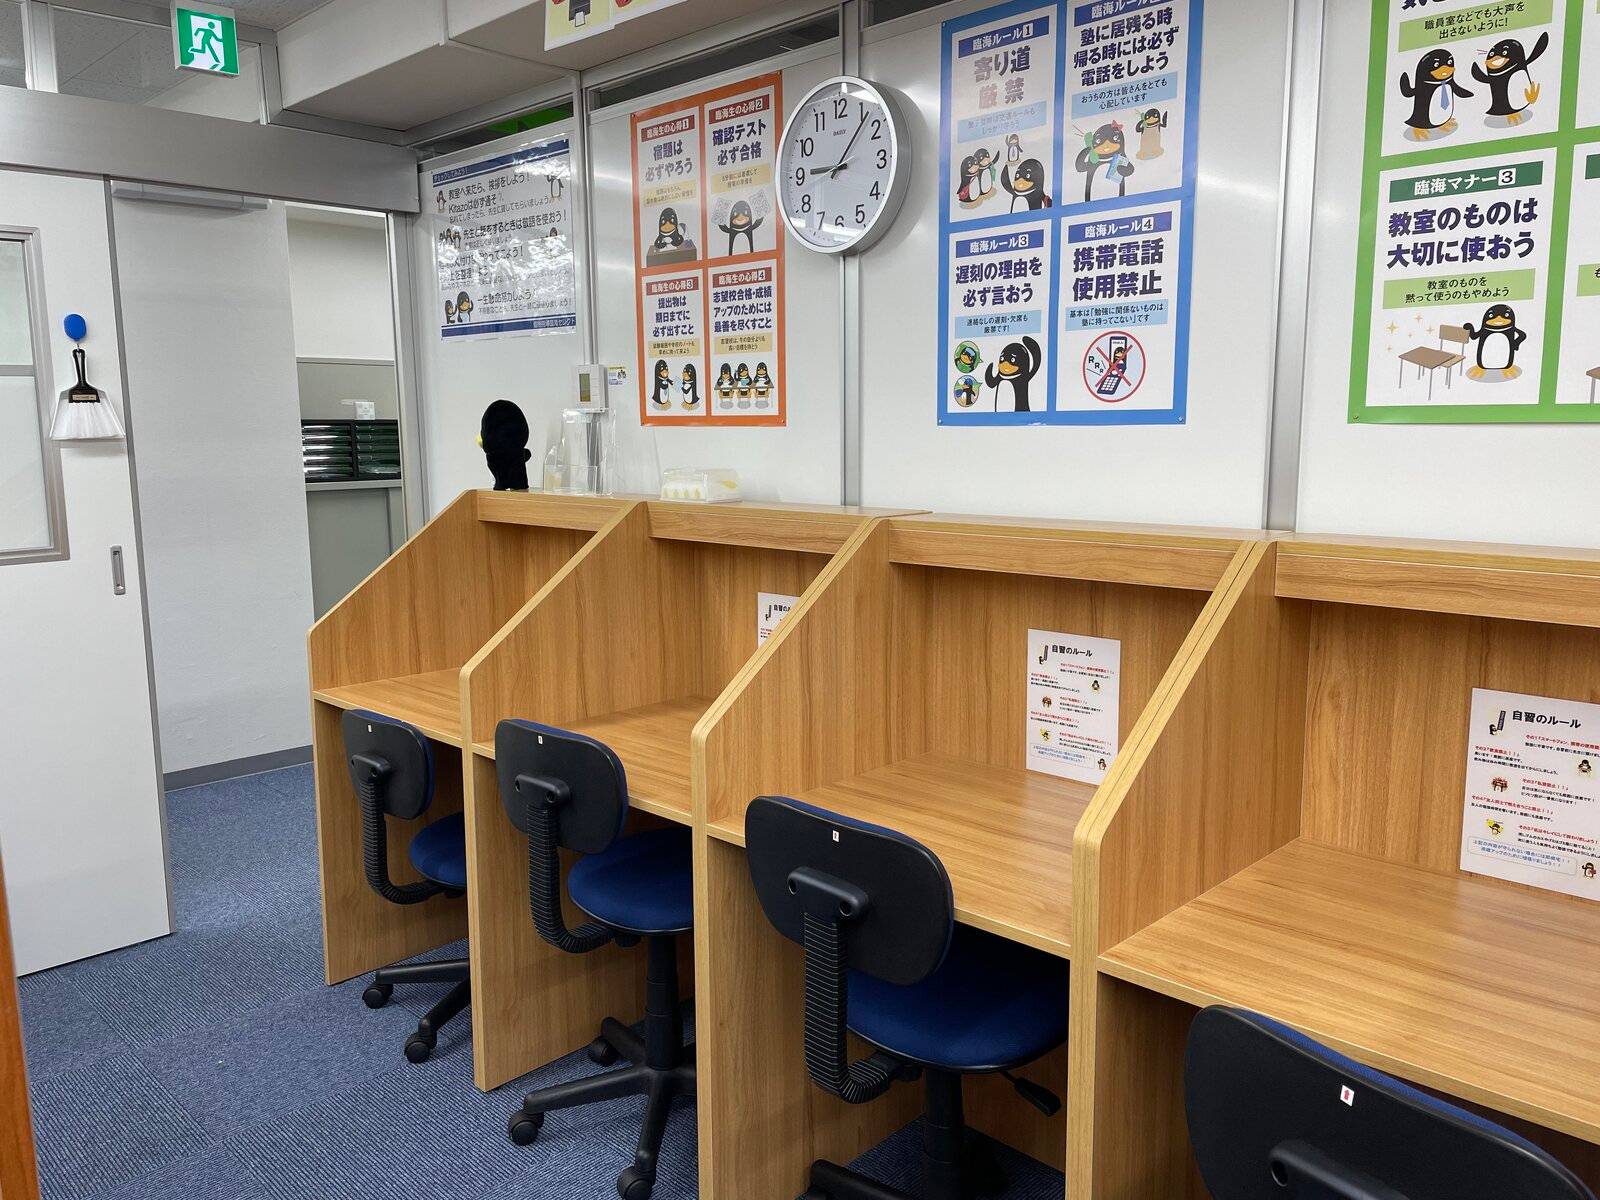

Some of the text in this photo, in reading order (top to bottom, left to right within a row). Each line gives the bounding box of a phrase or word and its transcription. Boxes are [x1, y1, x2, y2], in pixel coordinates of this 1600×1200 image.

[1091, 0, 1159, 18] 臨海ルー
[1424, 1, 1524, 30] 職員室などでも大声を
[972, 22, 1034, 51] 臨海ルール1
[1080, 7, 1173, 47] 塾に居残る時
[1073, 26, 1179, 69] 帰る時には必ず
[974, 45, 1031, 84] 寄り道
[1081, 52, 1169, 87] 電話をしよう
[1081, 78, 1168, 104] おうちの方は皆さんをとても
[1098, 93, 1148, 110] 心配しています
[715, 99, 763, 120] 臨海生の心得2
[833, 98, 848, 119] 12
[815, 111, 826, 132] 11
[871, 119, 881, 140] 2
[712, 119, 767, 146] 確認テスト
[653, 139, 683, 161] 宿題は
[717, 141, 762, 166] 必ず合格
[800, 137, 814, 158] 10
[876, 149, 887, 169] 3
[645, 158, 693, 182] 必ずやろう
[796, 167, 806, 186] 9
[869, 180, 881, 200] 4
[1414, 168, 1516, 196] 臨海マナー3
[801, 194, 811, 213] 8
[855, 204, 865, 224] 5
[816, 211, 826, 231] 7
[1084, 217, 1154, 239] 臨海ルール4
[1388, 197, 1538, 238] 教室のものは
[969, 234, 1029, 253] 臨海ルール3
[1386, 231, 1536, 269] 大切に使おう
[1073, 238, 1164, 272] 携帯電話
[955, 256, 1043, 285] 遅刻の理由を
[1072, 270, 1162, 302] 使用禁止
[1427, 276, 1488, 290] 教室のものを
[658, 296, 687, 309] 提出物は
[713, 286, 772, 303] 志望校合格・成績
[963, 282, 1033, 308] 必ず言おう
[1405, 287, 1510, 303] 黙って使うのもやめよう
[655, 310, 690, 323] 期日までに
[714, 302, 772, 318] アップのためには
[1069, 303, 1163, 318] 基本は「勉強に関係ないものは
[1081, 314, 1150, 327] 塾に持ってこない」です
[652, 324, 695, 338] 必ず出すこと
[714, 318, 772, 333] 最善を尽くすこと
[1052, 644, 1093, 657] 自習のルール
[1512, 710, 1581, 729] 自習のルール
